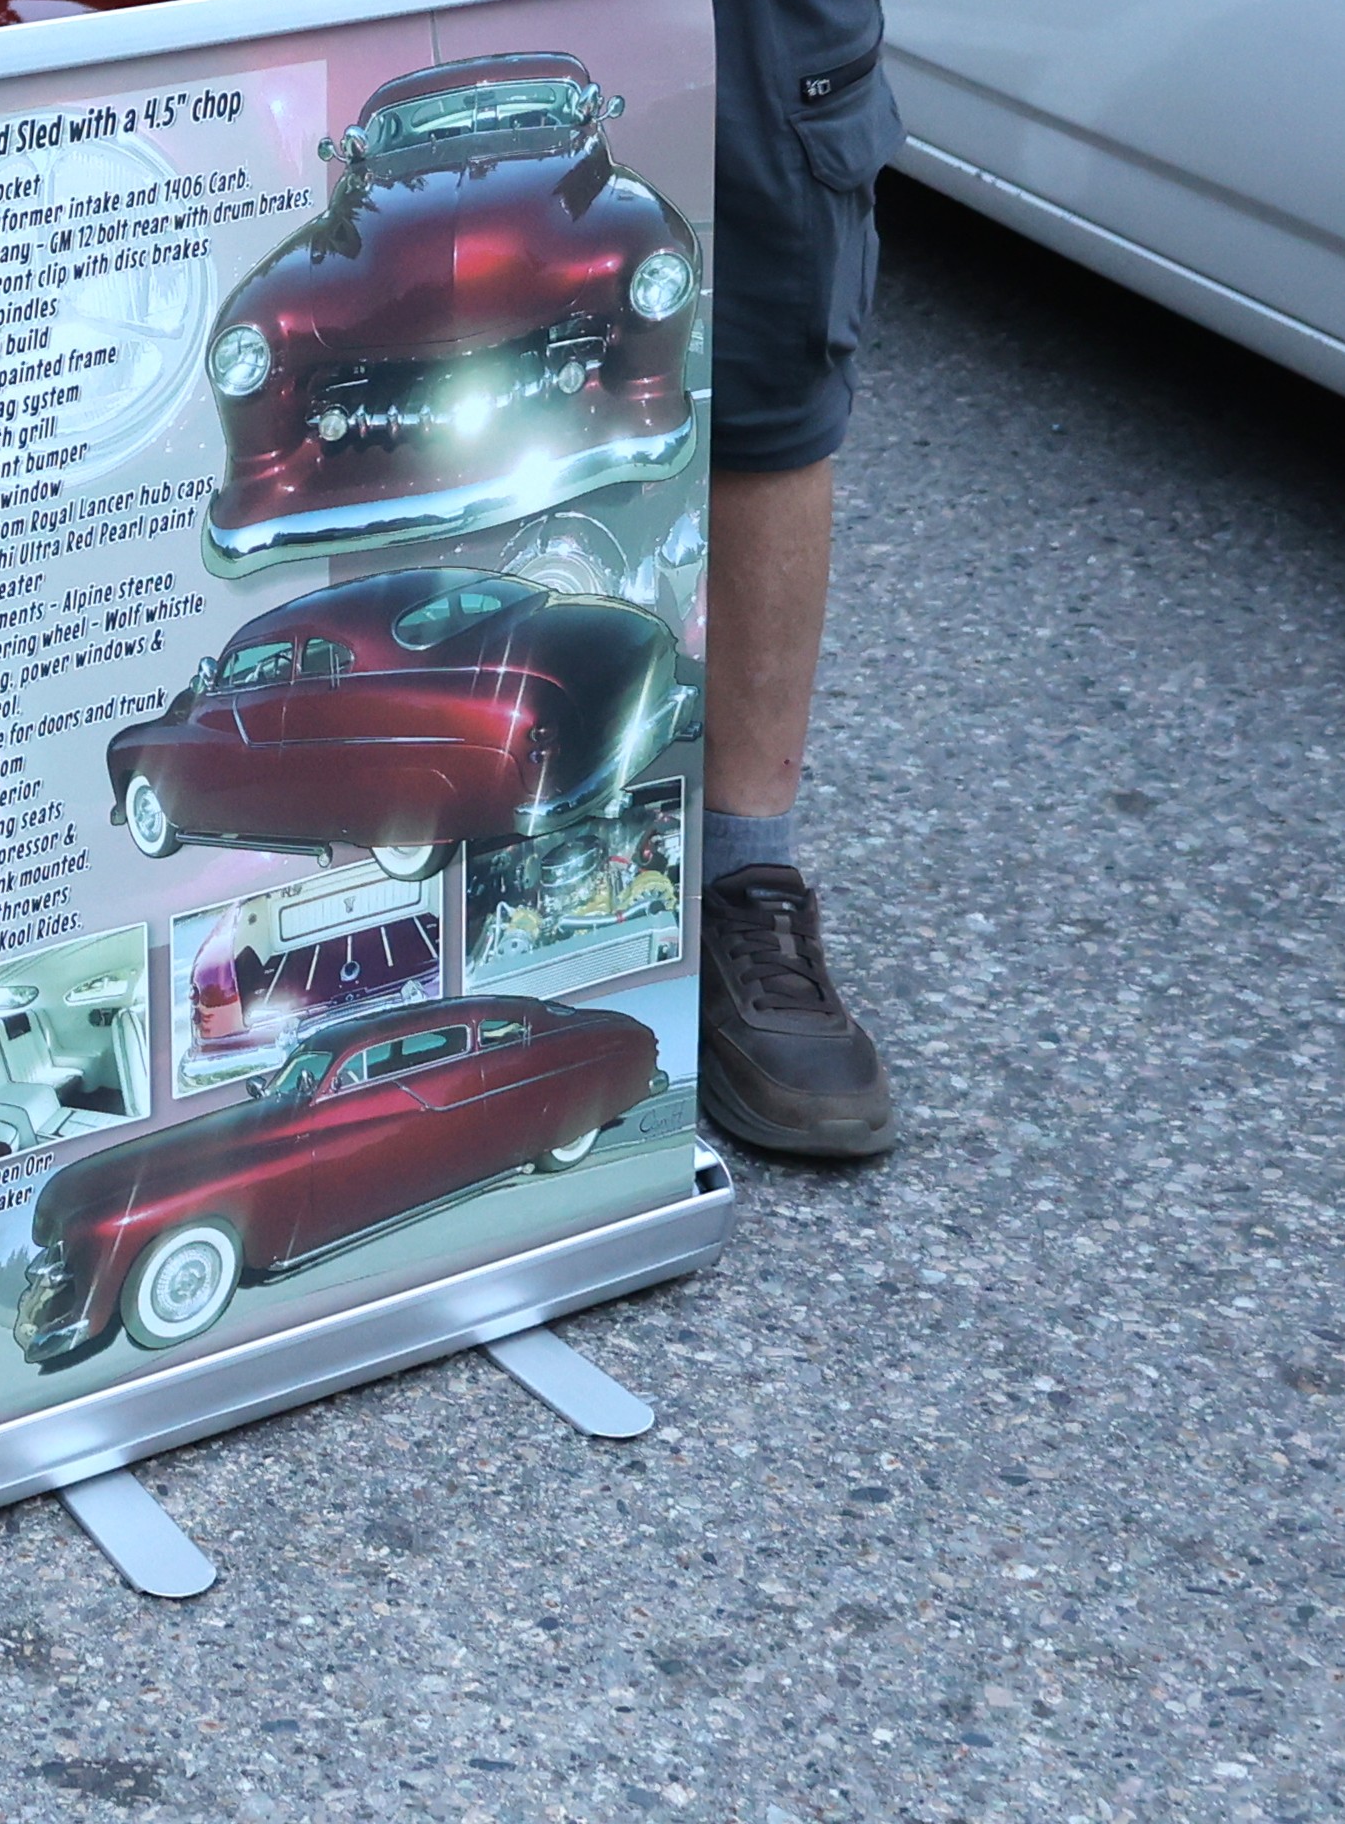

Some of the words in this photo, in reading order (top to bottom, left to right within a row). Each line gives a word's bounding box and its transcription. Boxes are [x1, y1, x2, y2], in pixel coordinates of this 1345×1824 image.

[14, 113, 65, 154] Sled
[68, 105, 120, 143] with
[122, 107, 139, 133] a
[143, 92, 190, 129] 4.5"
[191, 88, 241, 122] chop
[67, 190, 120, 219] intake
[125, 181, 161, 209] and
[163, 174, 206, 203] 1406
[49, 228, 75, 254] GM
[77, 223, 97, 249] 12
[96, 218, 129, 245] bolt
[131, 214, 172, 239] rear
[173, 203, 211, 231] with
[212, 199, 254, 224] drum
[37, 261, 69, 289] clip
[72, 252, 108, 280] with
[113, 246, 150, 272] disc
[151, 237, 209, 265] brakes
[5, 325, 49, 356] build
[67, 345, 116, 373] frame
[21, 384, 79, 417] system
[17, 415, 57, 450] grill
[24, 441, 90, 474] bumper
[0, 479, 62, 509] window
[29, 500, 77, 533] Royal
[77, 491, 138, 520] Lancer
[139, 480, 175, 506] hub
[176, 475, 213, 501] caps
[18, 538, 64, 567] Ultra
[65, 524, 98, 553] Red
[98, 514, 148, 545] Pearl
[147, 506, 195, 539] paint
[61, 583, 117, 615] Alpine
[117, 572, 173, 601] stereo
[41, 615, 89, 648] wheel
[104, 601, 142, 633] Wolf
[145, 593, 205, 624] whistle
[19, 654, 73, 688] power
[74, 635, 149, 668] windows
[149, 628, 162, 652] &
[8, 721, 36, 745] for
[37, 709, 84, 737] doors
[83, 696, 119, 724] and
[119, 686, 168, 716] trunk
[20, 800, 62, 830] seats
[62, 822, 75, 846] &
[25, 1153, 52, 1176] Orr
